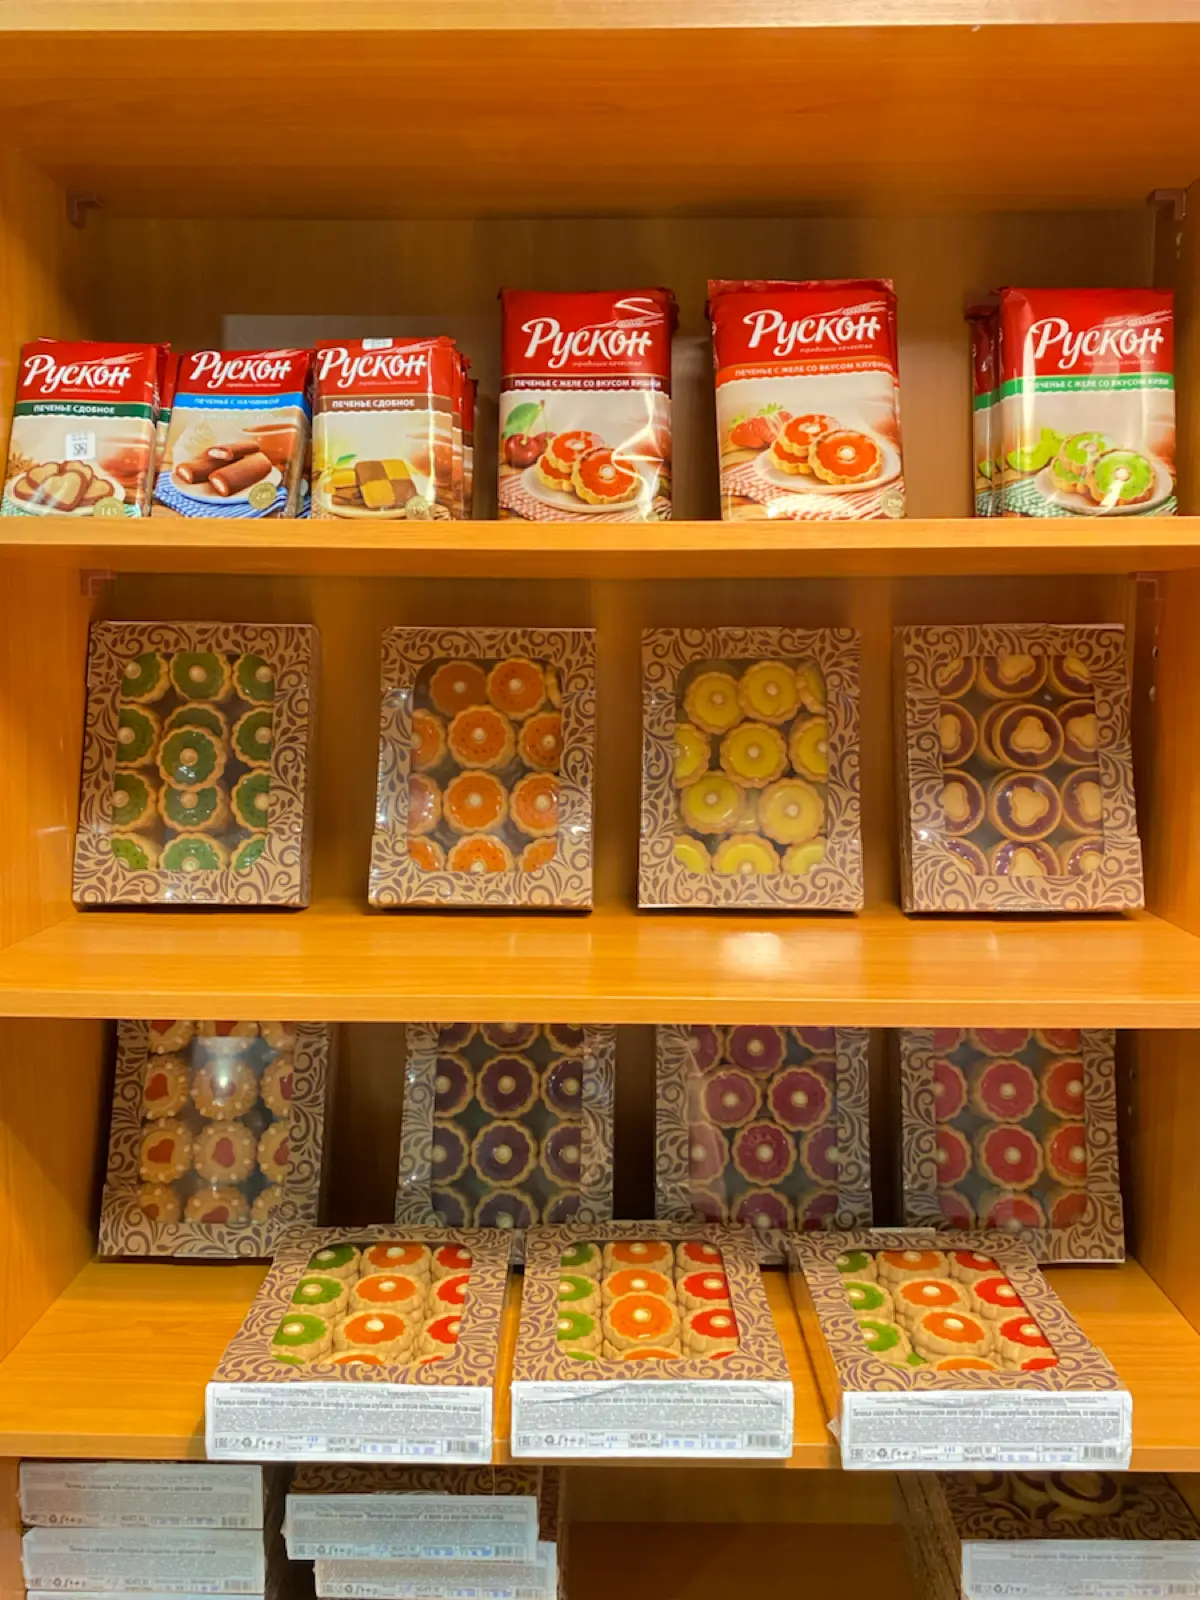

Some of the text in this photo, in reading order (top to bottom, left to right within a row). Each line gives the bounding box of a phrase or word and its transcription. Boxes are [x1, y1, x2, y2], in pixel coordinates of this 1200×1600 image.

[521, 317, 653, 369] Рускон
[742, 309, 881, 357] Рускон
[1031, 317, 1164, 369] Рускон
[23, 355, 131, 393] Рускон
[190, 351, 292, 388] Рускон
[317, 347, 427, 388] Рускон
[515, 379, 551, 387] ПЕЧЕНЬЕ
[735, 368, 772, 377] ПЕЧЕНЬЕ
[782, 365, 804, 373] ЖЕЛЕ
[806, 364, 818, 372] СО
[819, 362, 854, 371] ВКУСОМ
[1029, 381, 1065, 389] ЕЧЕНЬЕ
[1067, 380, 1073, 388] С
[1075, 380, 1096, 388] ЖЕЛЕ
[33, 404, 116, 414] ПЕЧЕНЬЕ СДОБНОЕ
[332, 399, 416, 408] ПЕЧЕНЬЕ СДОБНОЕ
